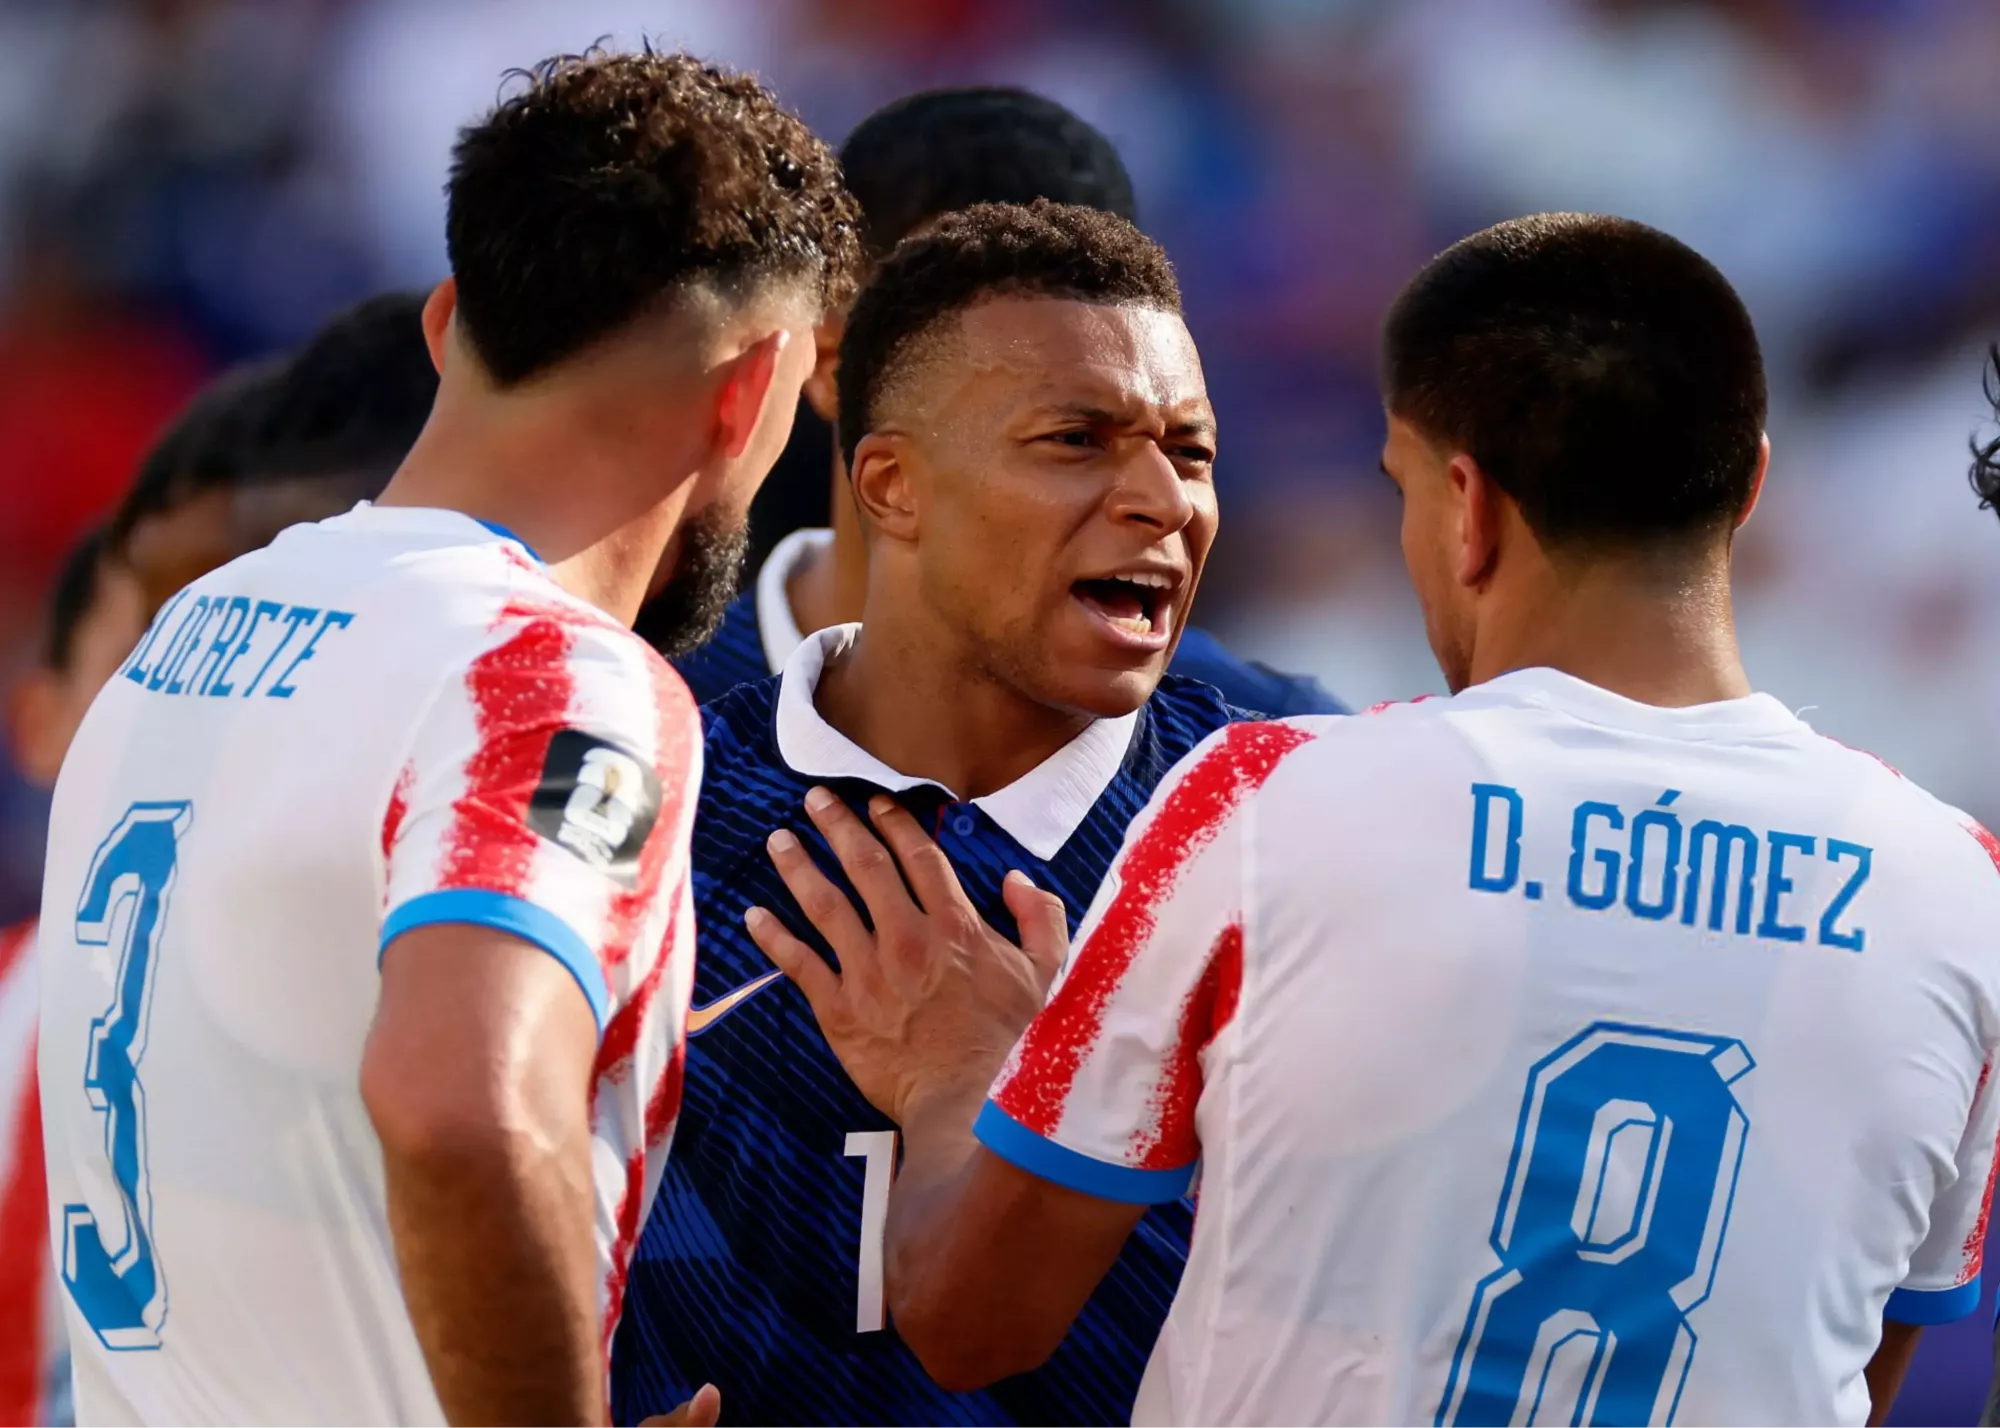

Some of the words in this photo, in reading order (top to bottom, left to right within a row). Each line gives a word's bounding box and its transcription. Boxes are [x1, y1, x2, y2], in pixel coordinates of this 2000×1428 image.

[119, 587, 357, 699] LDERETE
[1467, 782, 1544, 900] D.
[1566, 788, 1875, 953] GÓMEZ
[61, 799, 193, 1351] 3
[1433, 1020, 1757, 1428] 8
